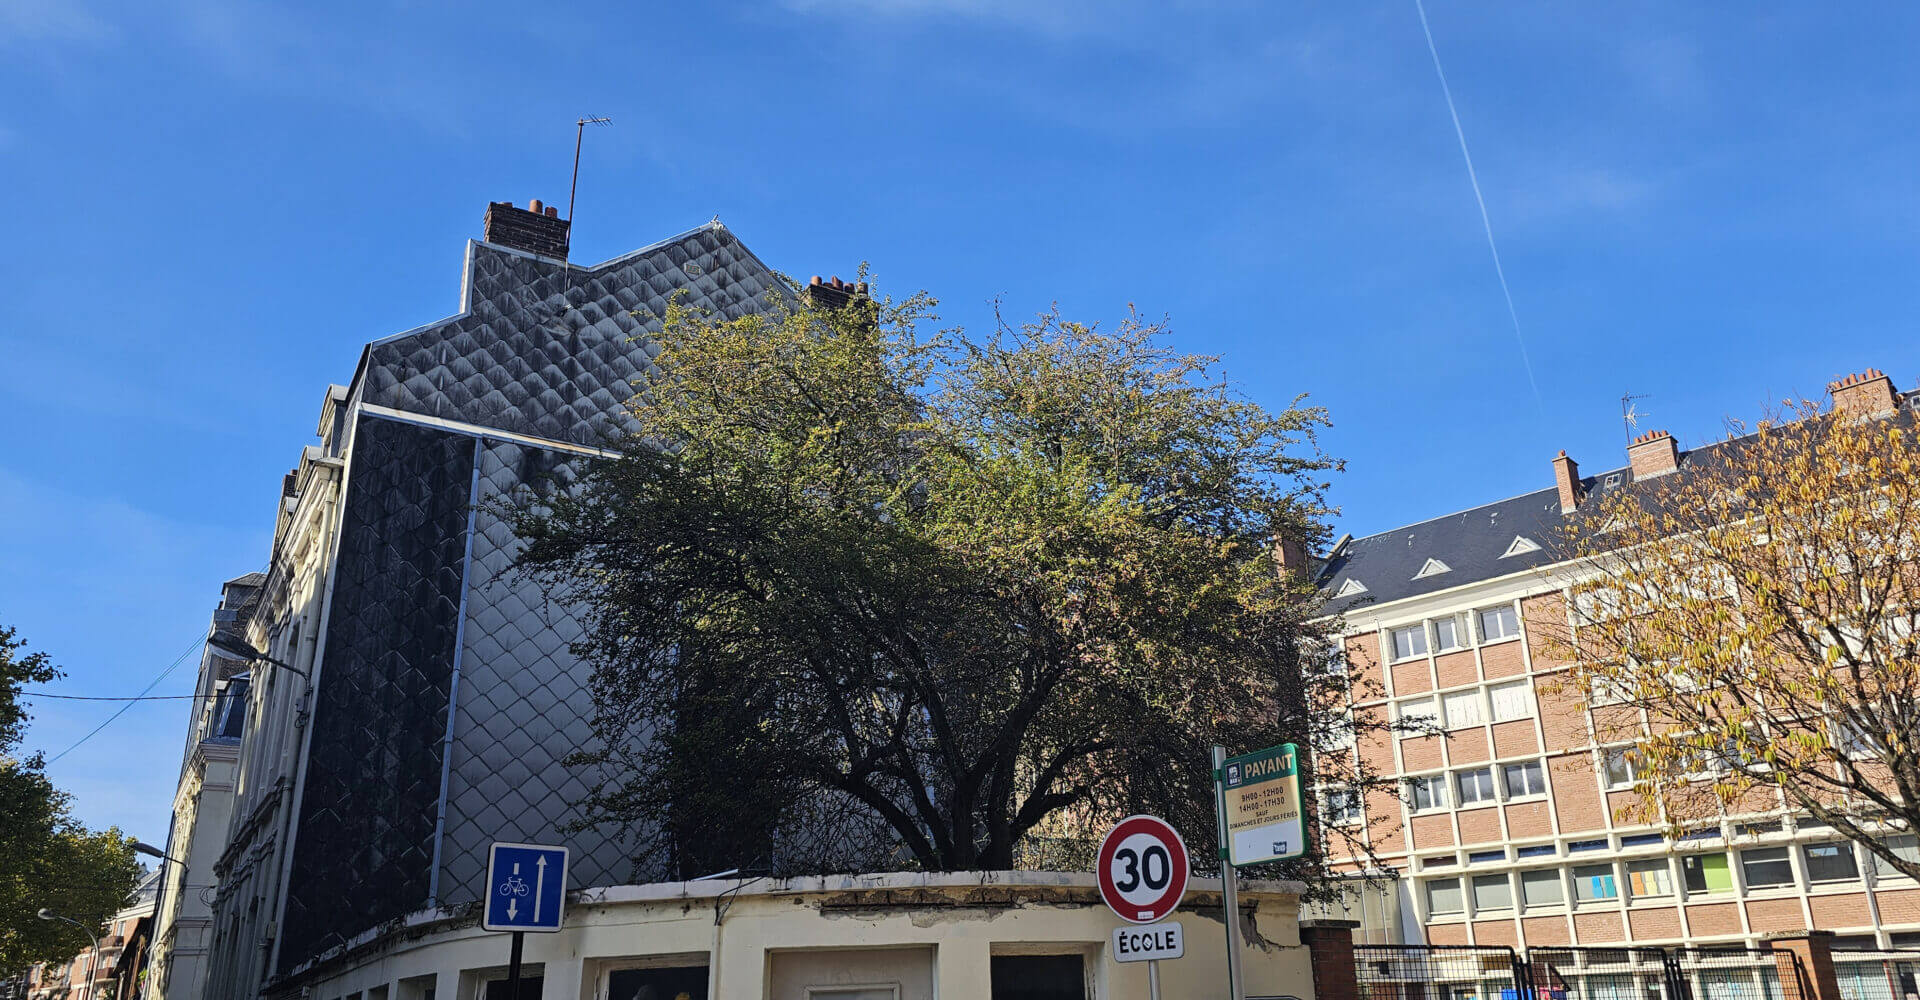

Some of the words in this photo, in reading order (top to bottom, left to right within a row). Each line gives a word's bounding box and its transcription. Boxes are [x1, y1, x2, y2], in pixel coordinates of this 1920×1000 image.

[1245, 754, 1292, 778] PAYANT
[1263, 786, 1284, 797] 12H00
[1239, 802, 1259, 813] 14H00
[1264, 797, 1285, 807] 17H30
[1229, 820, 1257, 830] DIMANCHES
[1263, 814, 1279, 823] JOURS
[1115, 845, 1169, 892] 30
[1119, 931, 1176, 953] ÉCOLE
